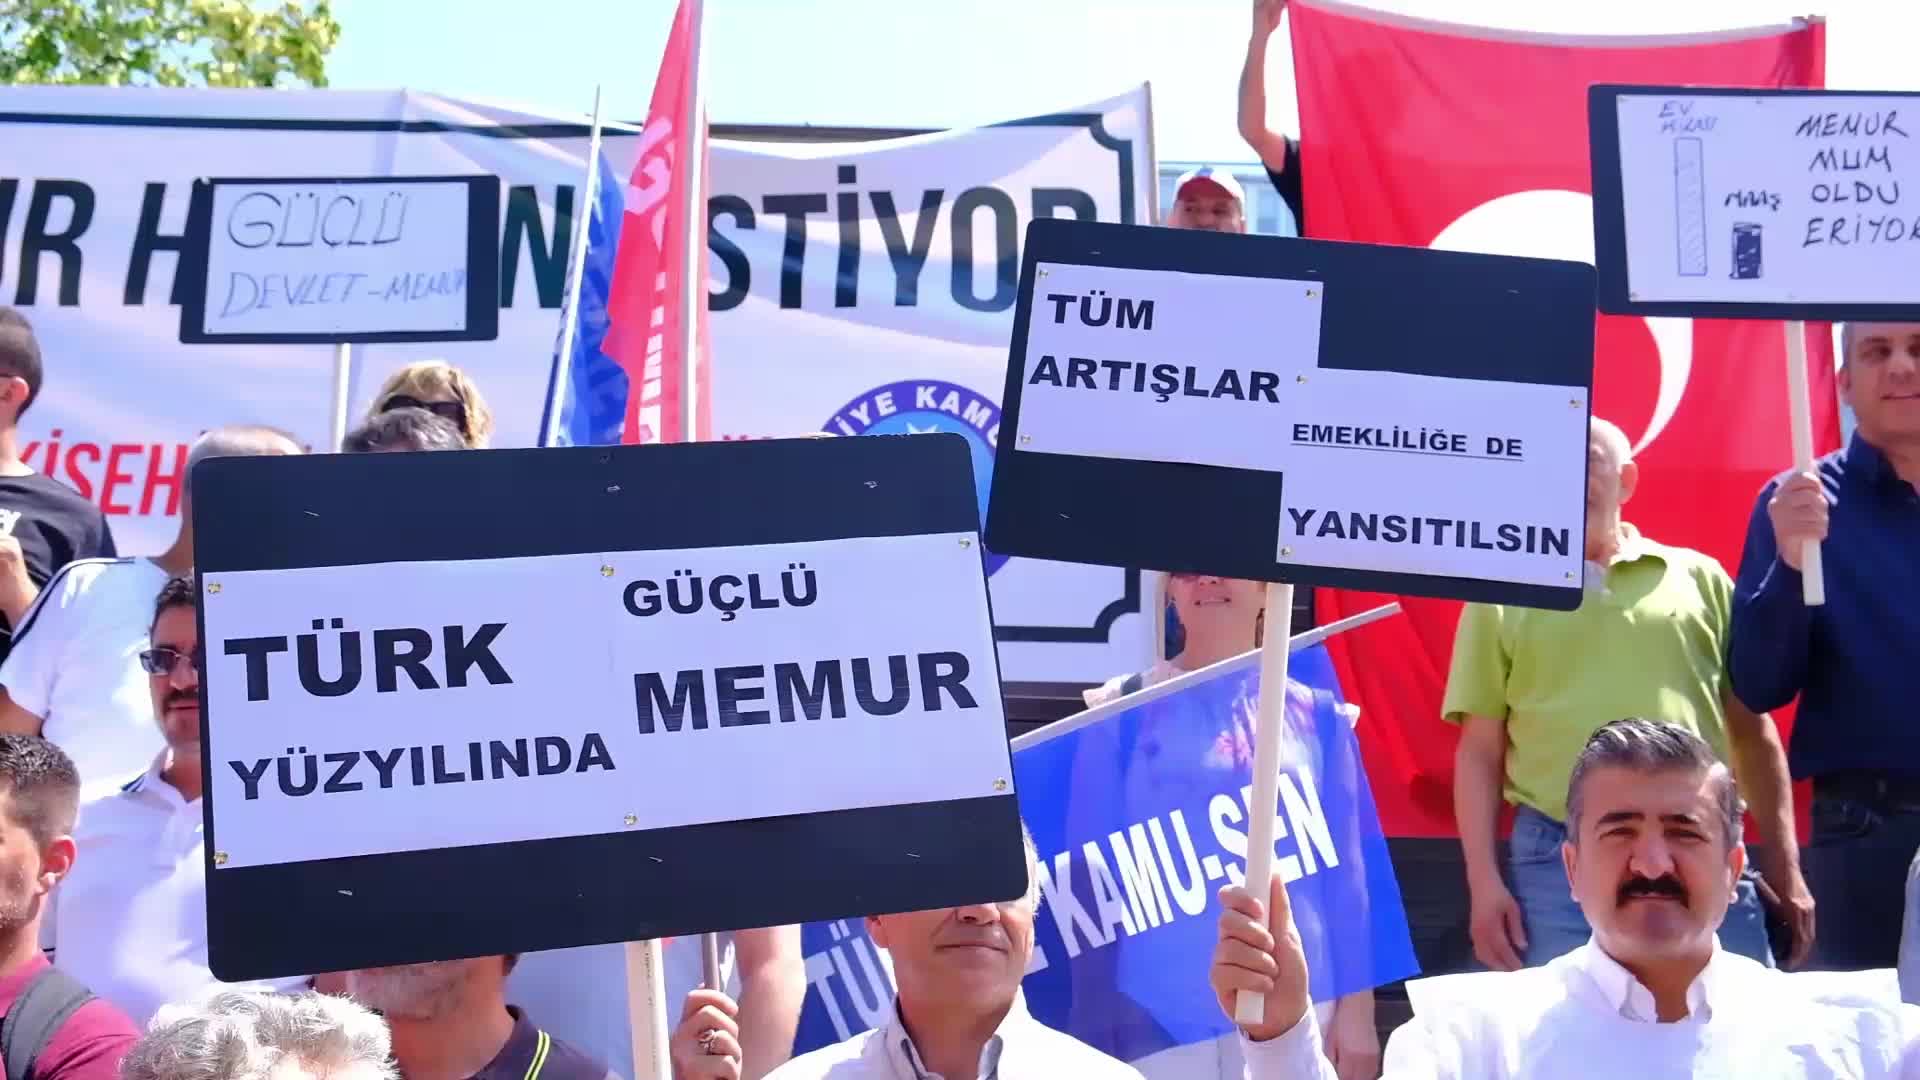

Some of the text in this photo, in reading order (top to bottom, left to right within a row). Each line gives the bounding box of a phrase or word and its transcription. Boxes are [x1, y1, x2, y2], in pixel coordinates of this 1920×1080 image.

[1796, 110, 1909, 138] MEMUR
[1808, 145, 1892, 173] MUM
[1811, 181, 1900, 206] OLDU
[1047, 290, 1154, 330] TÜM
[1028, 355, 1280, 403] ARTIŞLAR
[1292, 423, 1523, 456] EMEKLİLİĞE DE
[1288, 508, 1569, 556] YANSITILSIN
[623, 563, 818, 622] GÜÇLÜ
[224, 618, 513, 701] TÜRK
[634, 651, 979, 734] MEMUR
[228, 733, 616, 800] YÜZYILINDA
